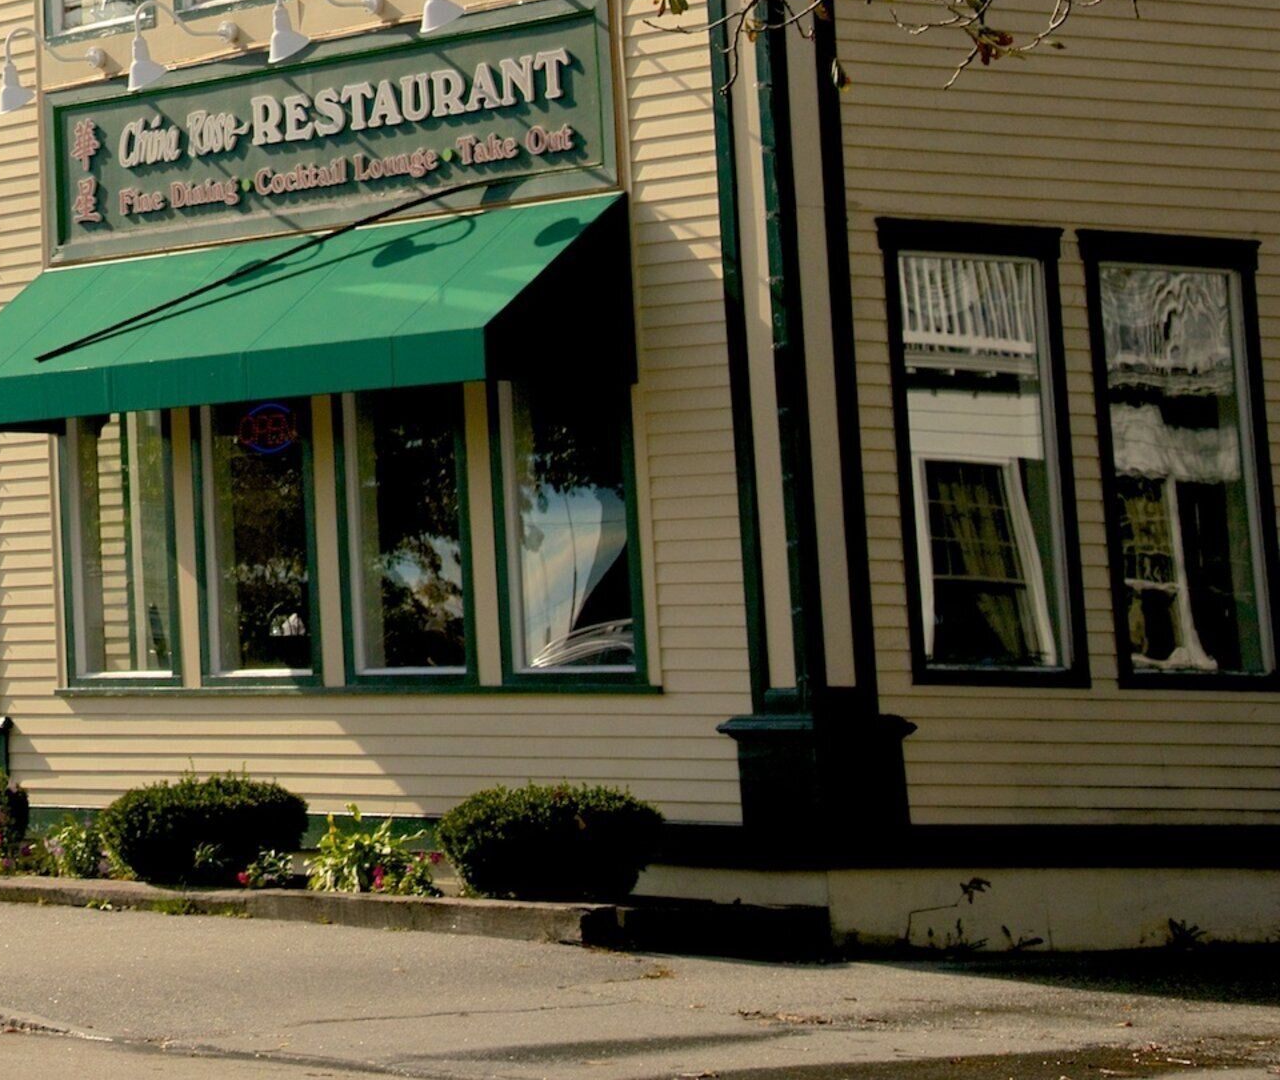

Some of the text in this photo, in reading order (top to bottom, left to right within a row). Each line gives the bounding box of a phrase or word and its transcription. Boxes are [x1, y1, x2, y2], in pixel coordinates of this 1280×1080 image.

[118, 48, 571, 169] China Rose RESTAURANT
[118, 123, 574, 216] Fine Dining Cocktail Lounge Take Out
